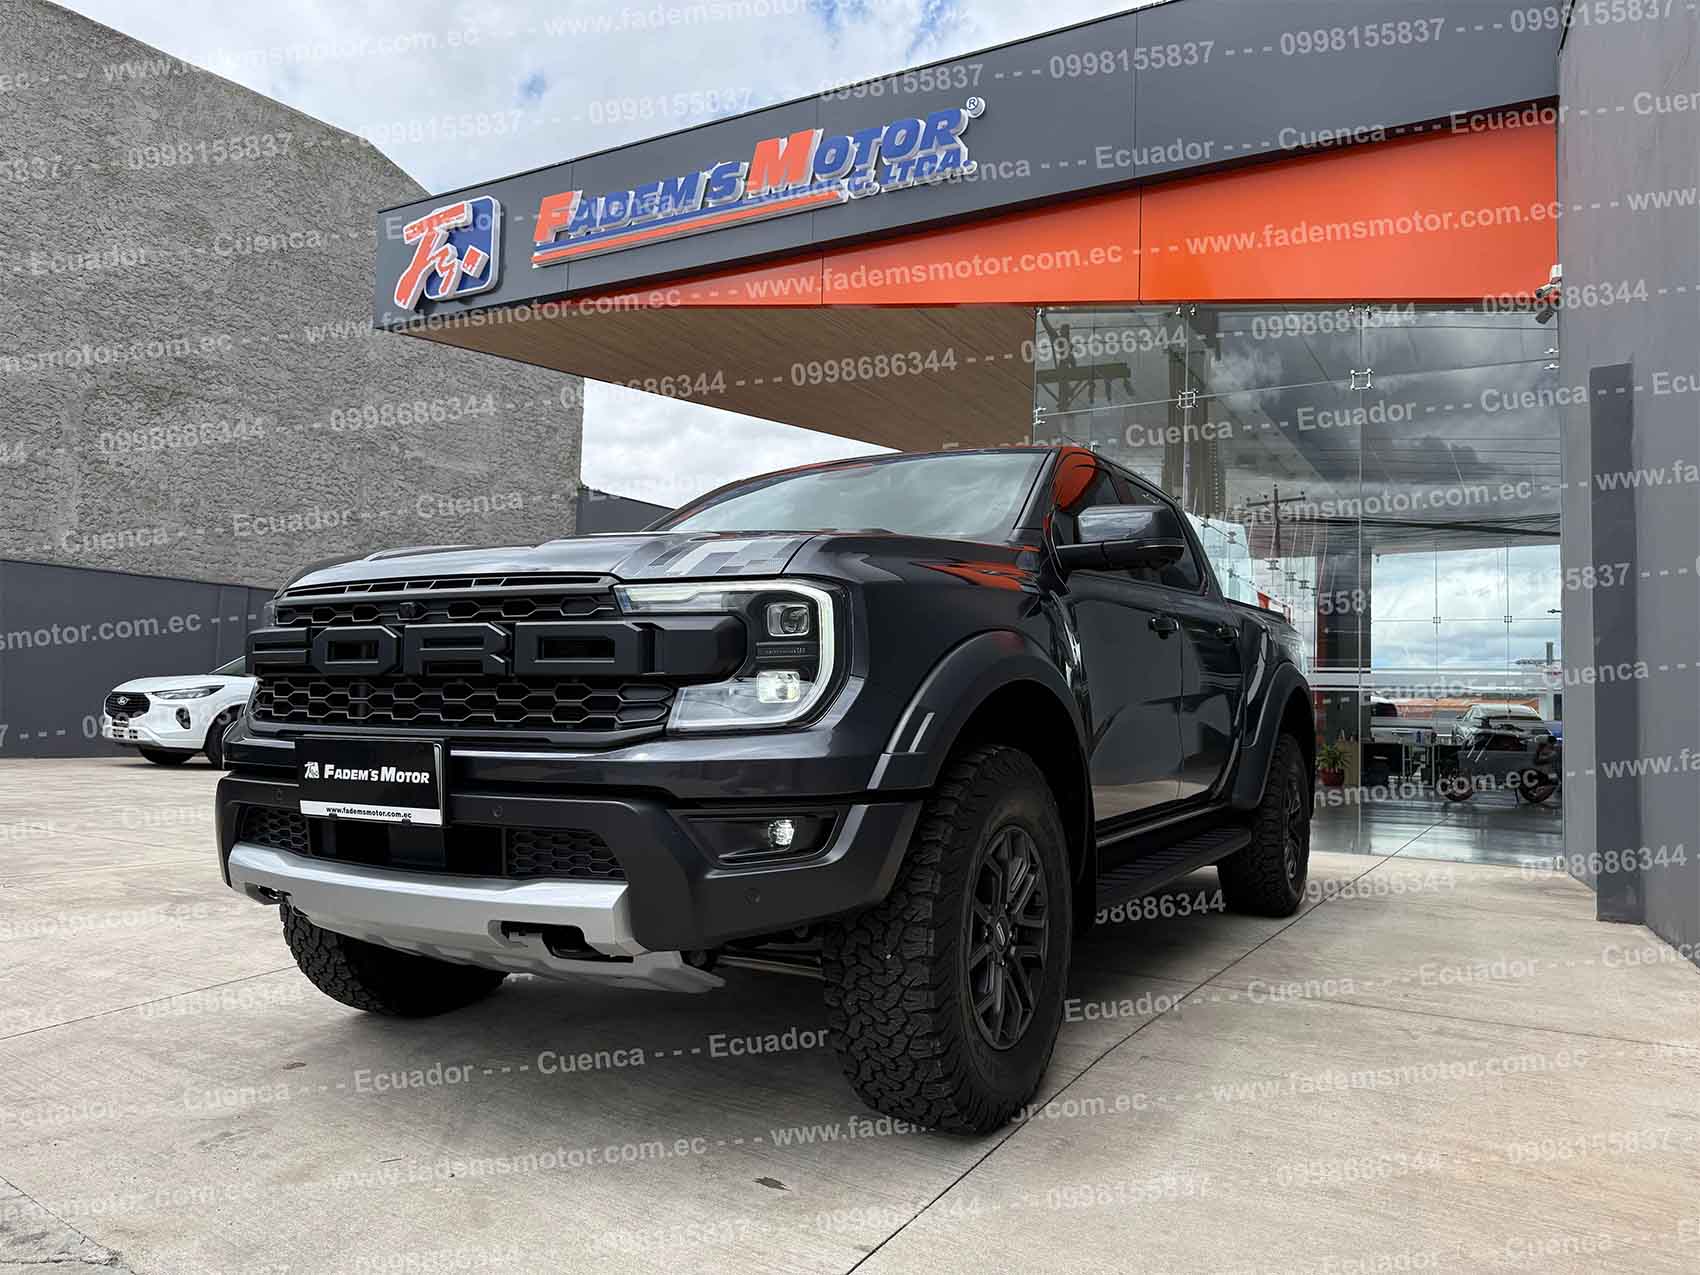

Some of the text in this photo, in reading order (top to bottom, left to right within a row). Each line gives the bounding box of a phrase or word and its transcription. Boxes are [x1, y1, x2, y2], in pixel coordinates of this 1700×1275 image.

[746, 107, 968, 194] MOTOR
[380, 766, 430, 784] MOTOR
[325, 807, 412, 819] www.fademsmotor.com.ec
